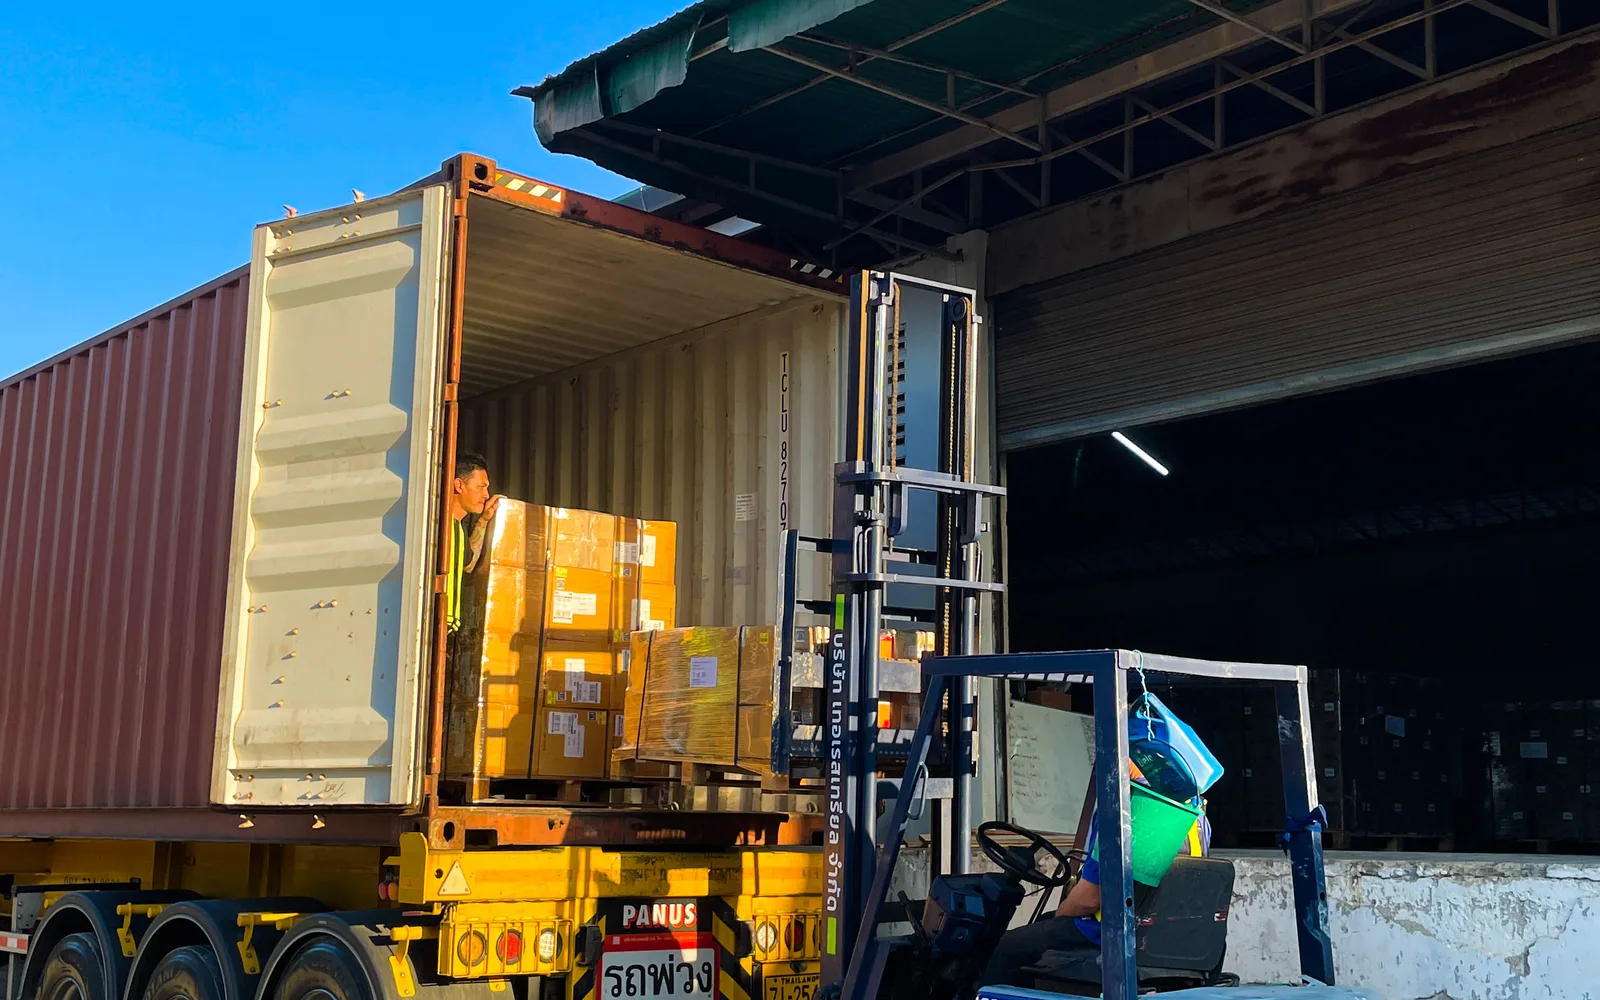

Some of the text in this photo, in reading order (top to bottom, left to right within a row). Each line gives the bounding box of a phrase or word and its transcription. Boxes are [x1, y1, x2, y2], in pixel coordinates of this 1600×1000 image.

[832, 633, 846, 693] บริษัท
[827, 852, 842, 911] จำกัด
[622, 903, 697, 929] PANUS
[604, 954, 713, 998] รถพ่วง
[781, 975, 815, 985] THAILAND
